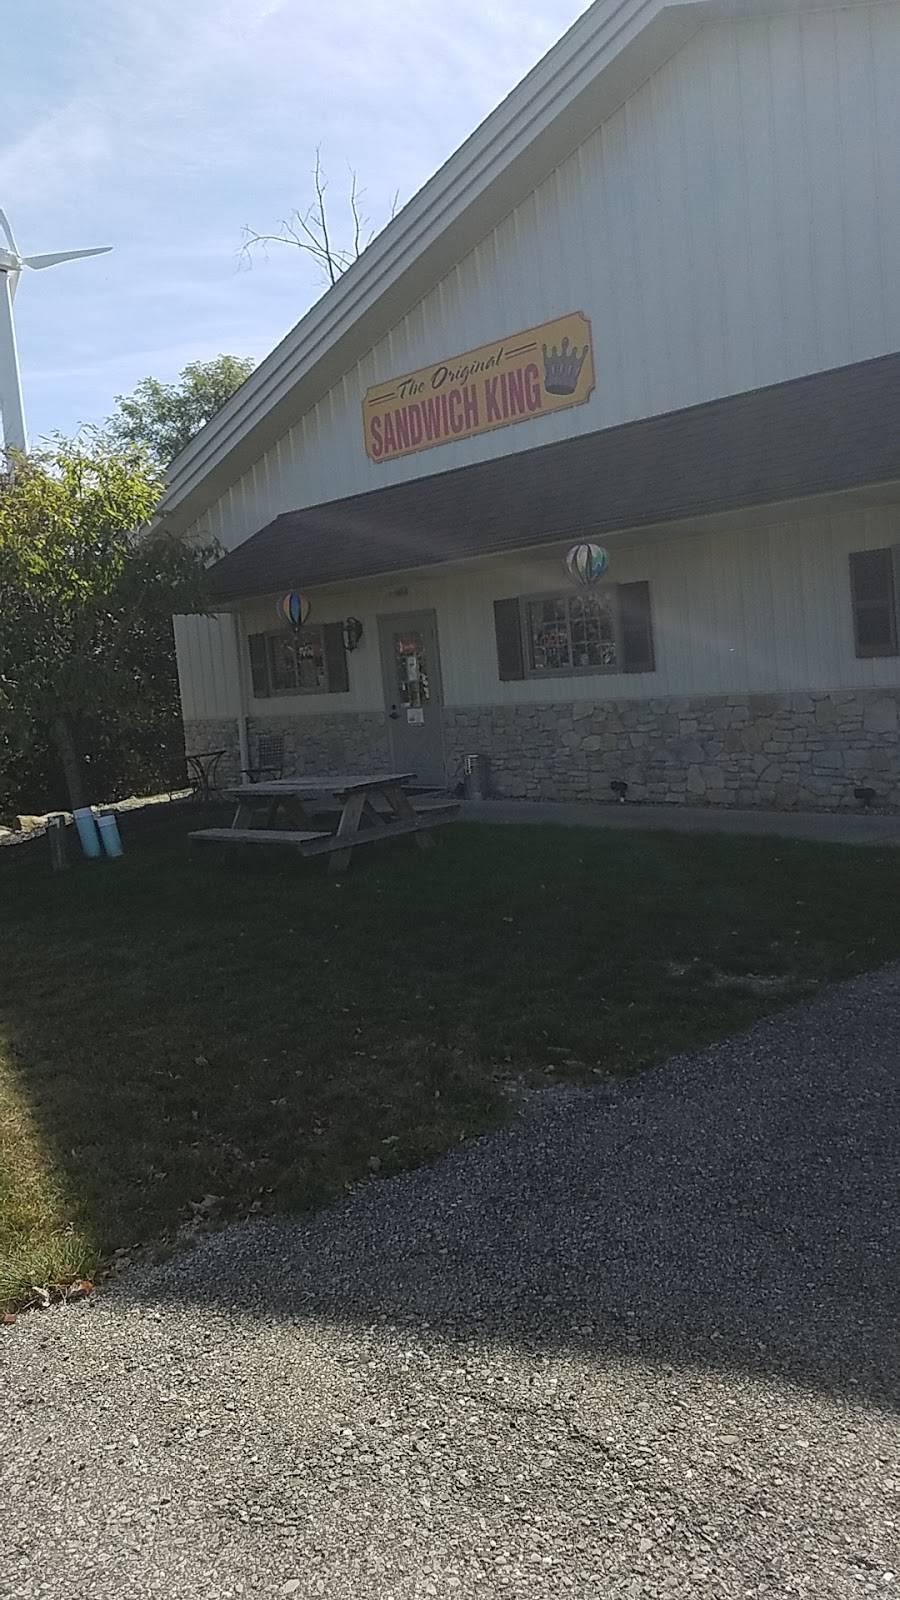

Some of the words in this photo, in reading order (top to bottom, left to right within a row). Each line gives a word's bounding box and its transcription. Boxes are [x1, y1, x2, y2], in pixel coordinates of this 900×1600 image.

[370, 384, 479, 457] SANDWICH
[485, 363, 542, 422] KING
[398, 379, 424, 400] The
[432, 349, 503, 386] Original
